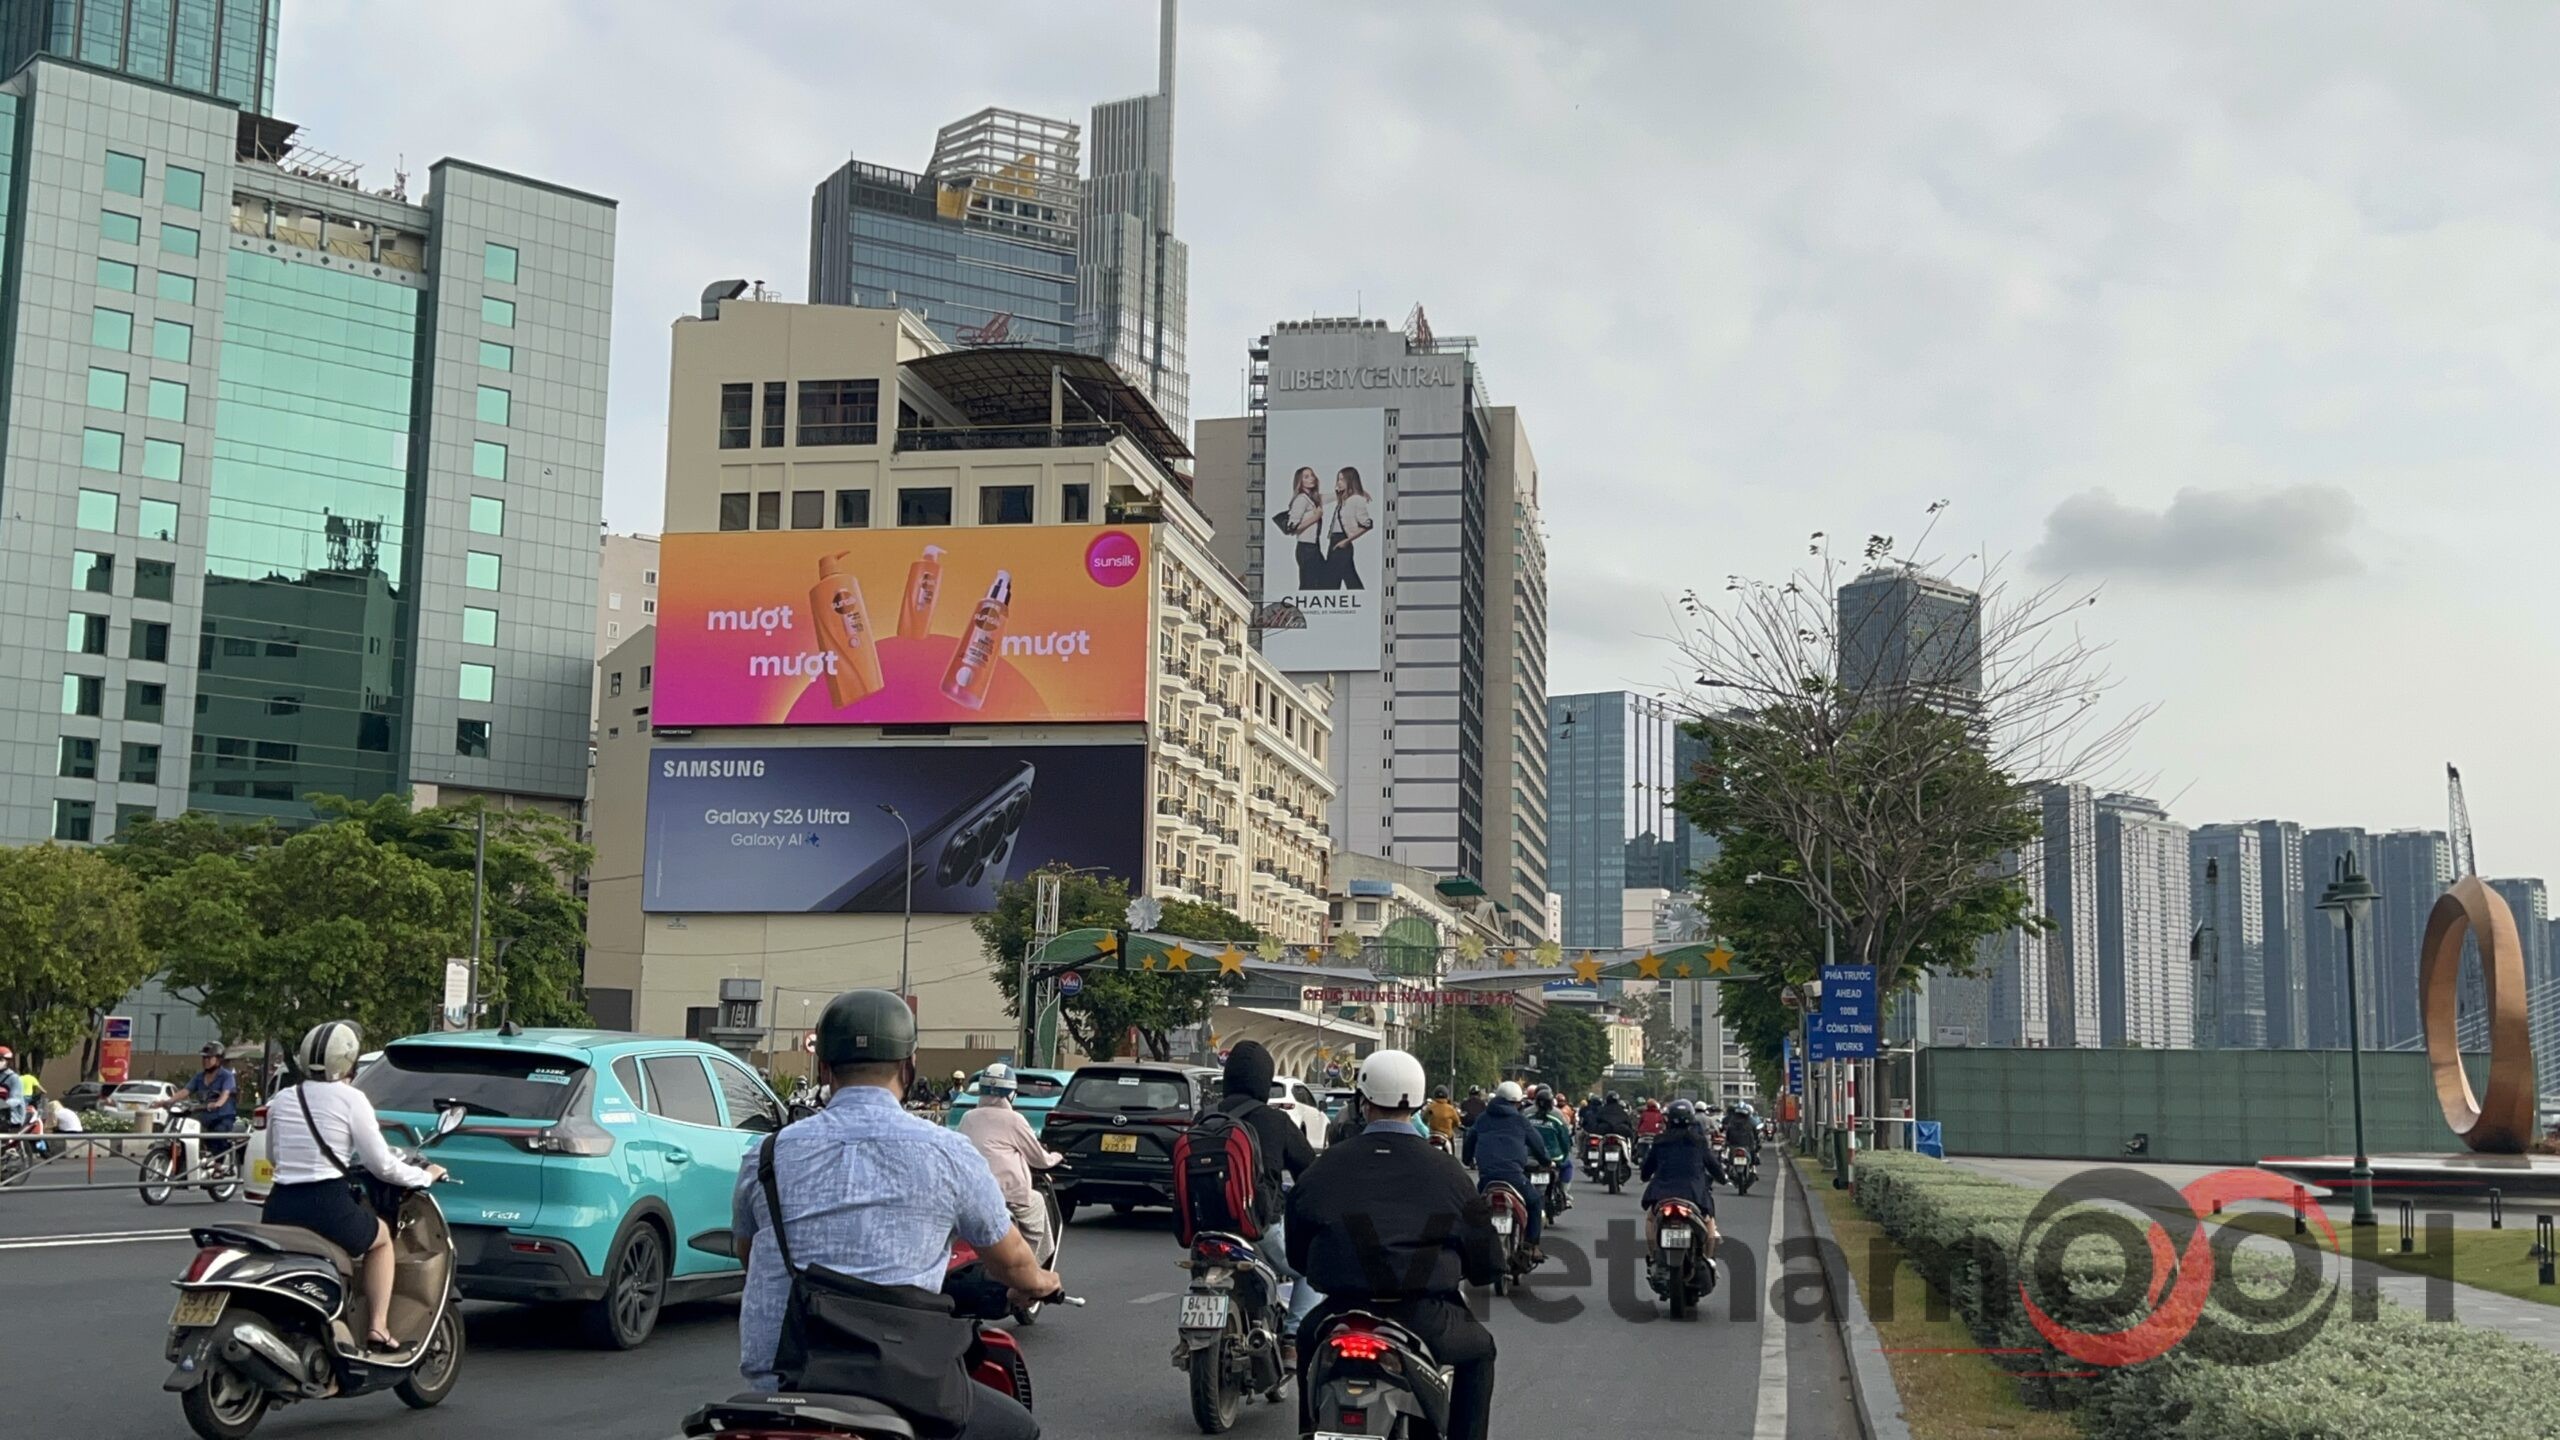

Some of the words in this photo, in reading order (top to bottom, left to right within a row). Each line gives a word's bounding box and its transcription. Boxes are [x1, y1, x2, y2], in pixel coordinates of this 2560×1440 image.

[1279, 368, 1359, 391] LIBERTY
[1360, 365, 1456, 389] CENTRAL
[1093, 555, 1135, 568] sunsilk
[1281, 595, 1361, 608] CHANEL
[707, 605, 793, 636] mượt
[1001, 630, 1090, 662] mượt
[749, 650, 838, 682] mượt
[663, 760, 765, 778] SAMSUNG
[705, 809, 770, 828] Galaxy
[773, 809, 803, 824] S26
[807, 808, 850, 824] Ultra
[731, 833, 785, 850] Galaxy
[788, 833, 802, 846] AI
[1835, 989, 1862, 998] AHEAD
[1835, 1042, 1864, 1052] WORKS
[1187, 1297, 1219, 1311] 84-L1
[1182, 1312, 1223, 1327] 270.17
